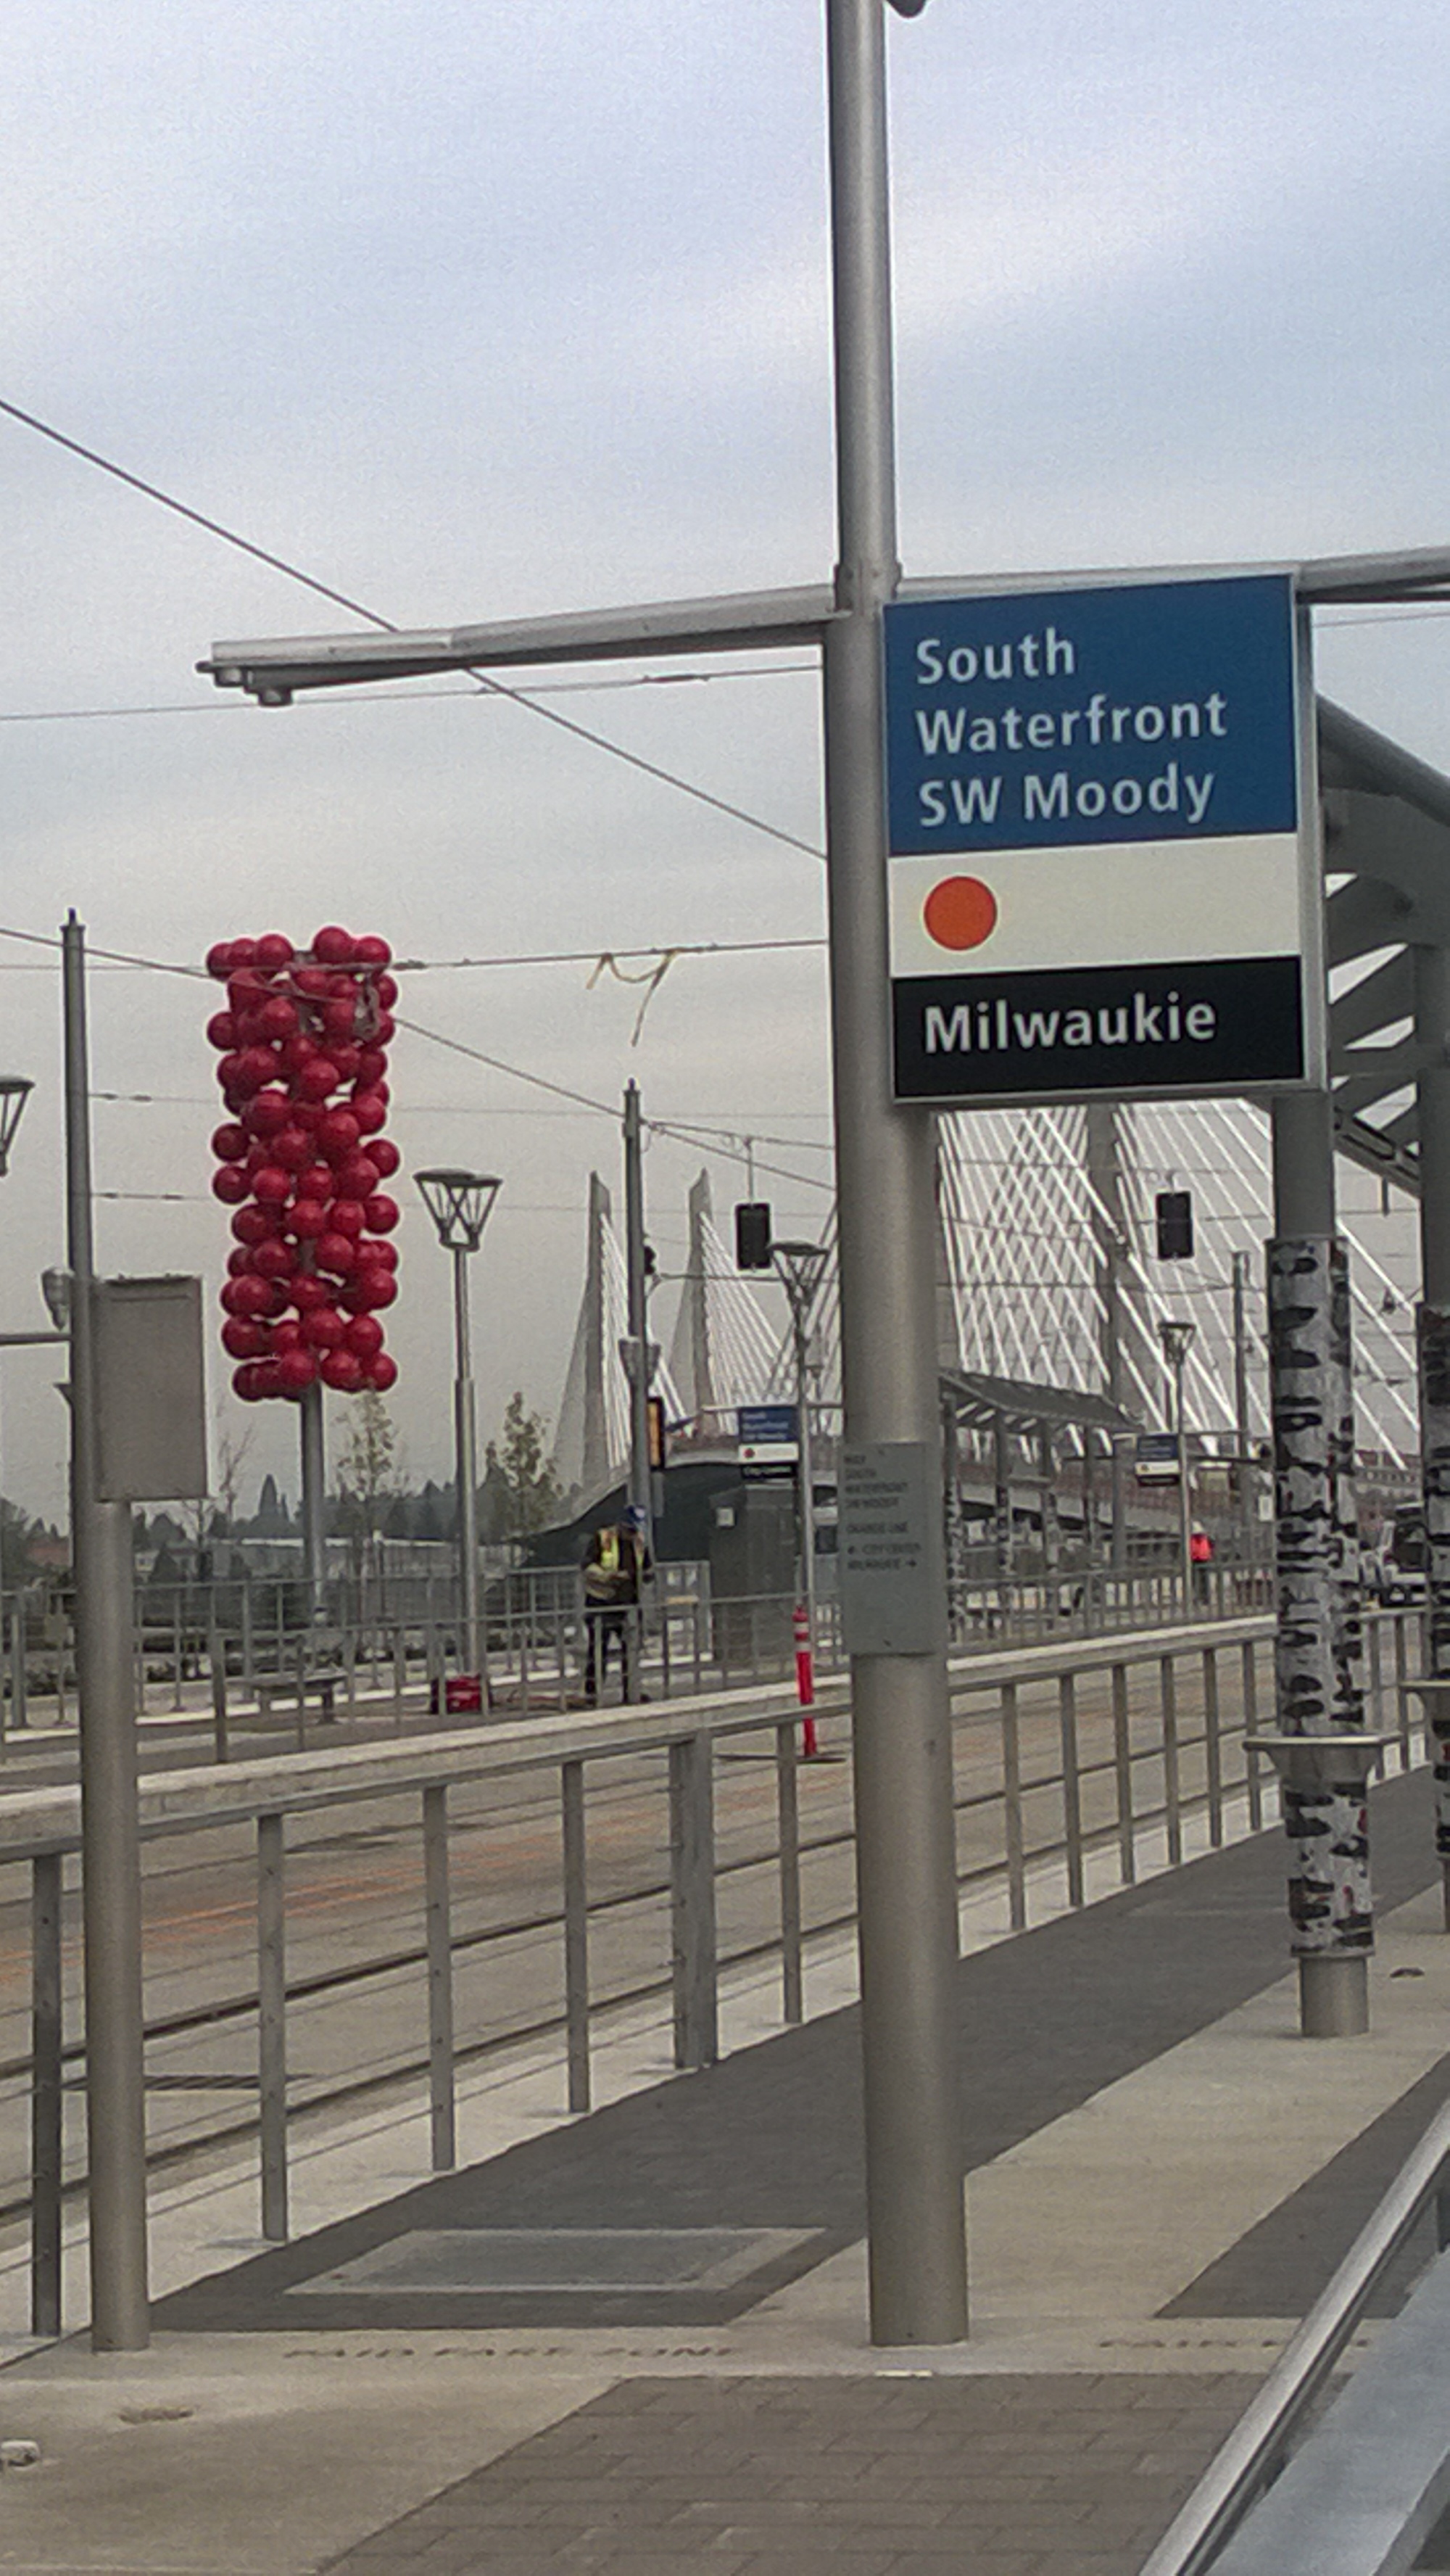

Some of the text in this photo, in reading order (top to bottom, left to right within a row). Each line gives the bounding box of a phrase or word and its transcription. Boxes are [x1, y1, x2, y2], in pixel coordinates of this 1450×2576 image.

[917, 627, 1074, 684] South
[917, 694, 1225, 754] Waterfront
[920, 763, 1212, 827] SW Moody
[925, 992, 1215, 1053] Milwaukie
